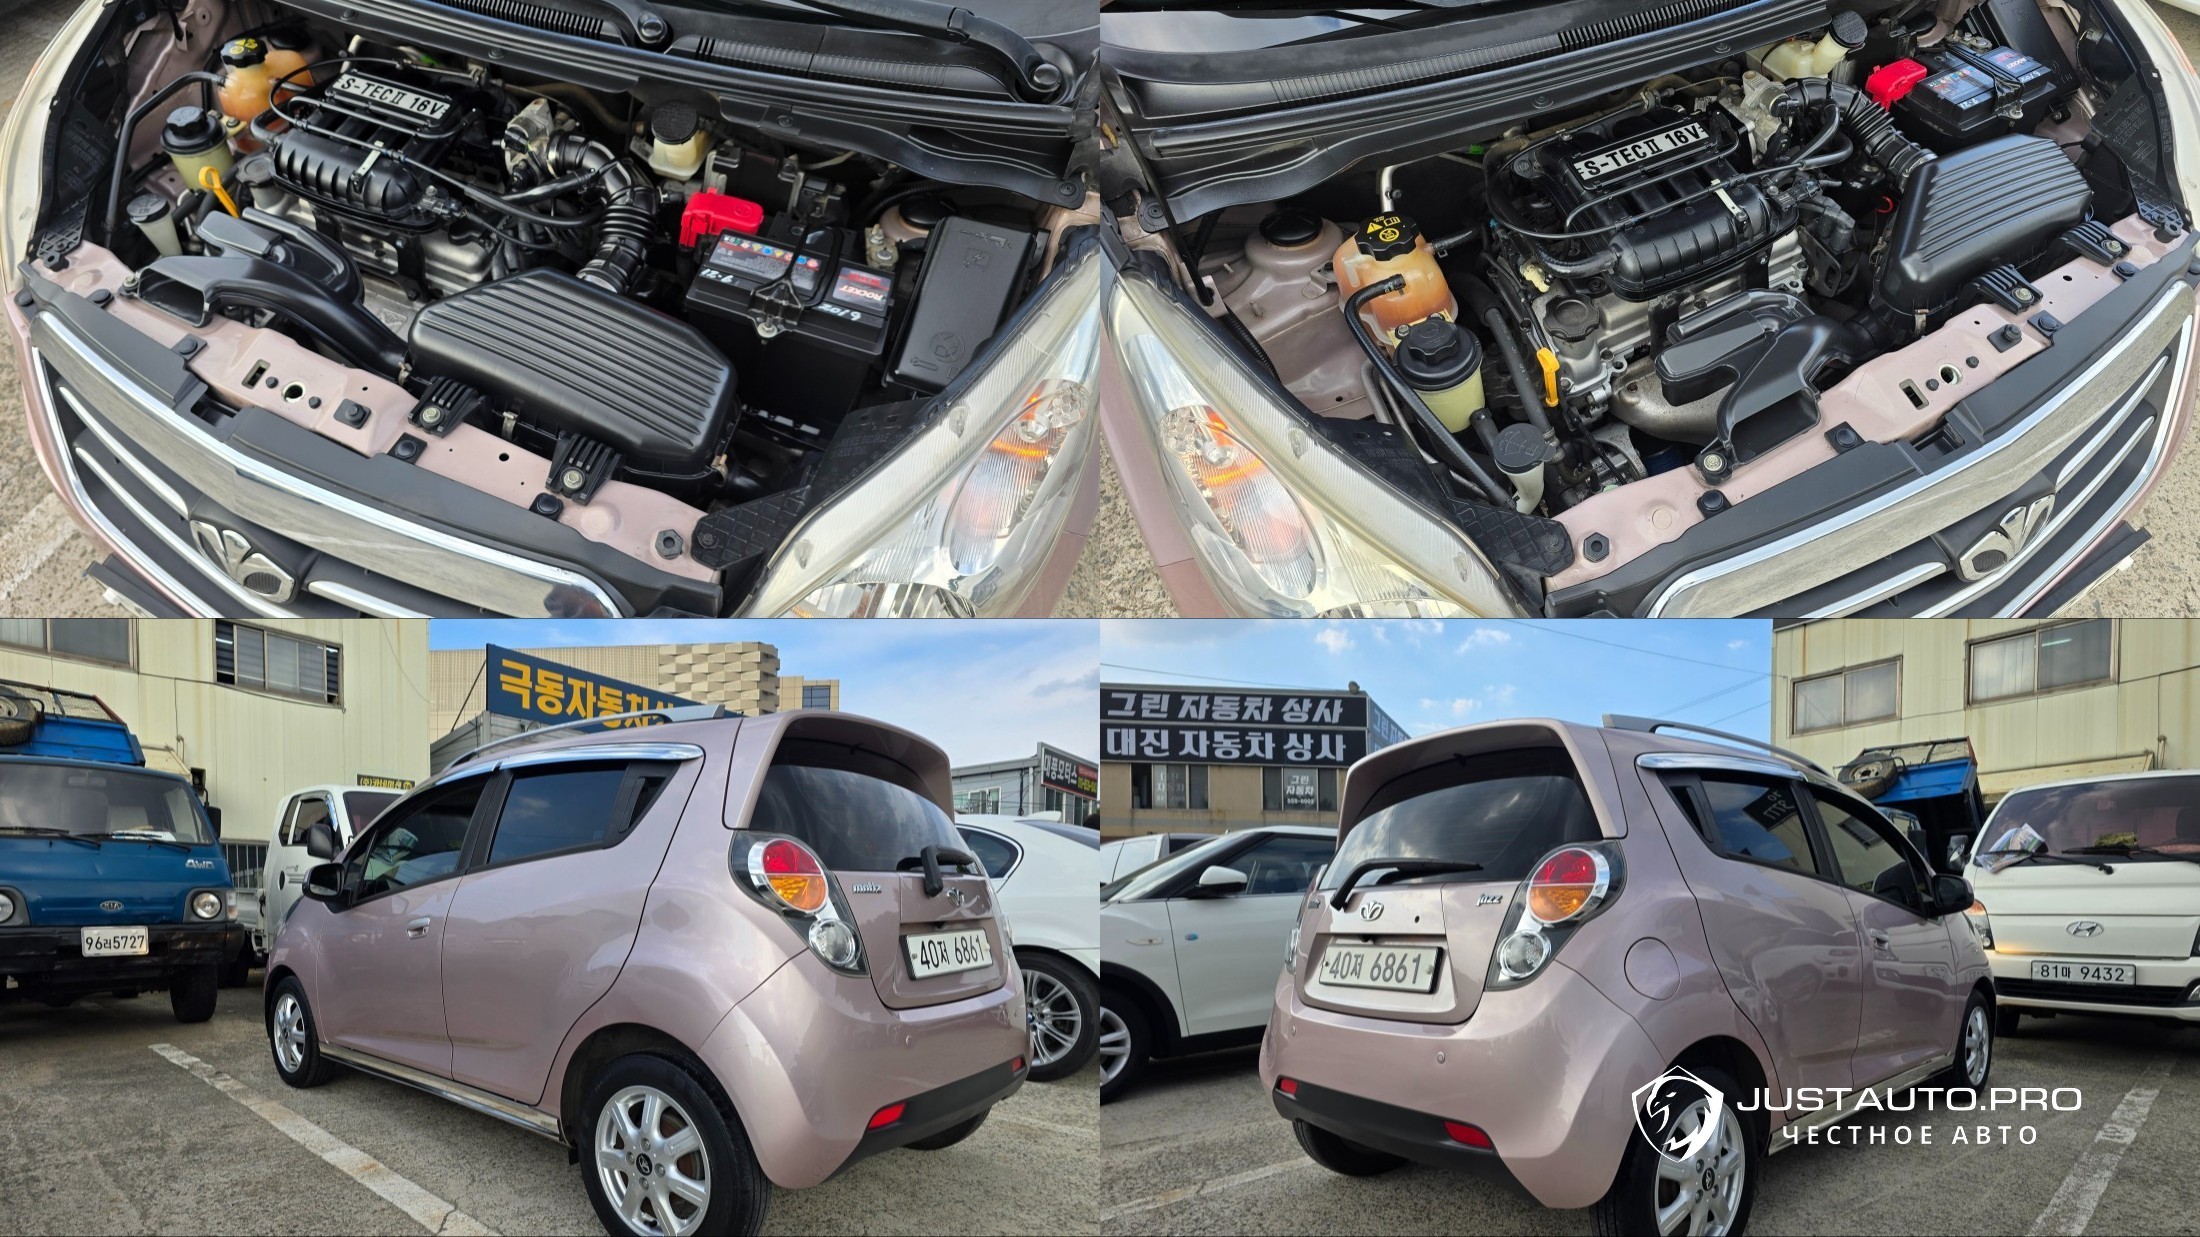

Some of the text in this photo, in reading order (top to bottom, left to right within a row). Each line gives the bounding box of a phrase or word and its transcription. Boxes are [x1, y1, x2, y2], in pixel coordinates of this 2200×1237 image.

[409, 97, 445, 116] 16V
[1665, 125, 1702, 148] 16V
[841, 284, 884, 302] ROCKET
[1107, 691, 1344, 724] 그린 자동차 상사
[1106, 728, 1347, 762] 대진 자동차 상사
[102, 901, 121, 910] KIA
[954, 933, 985, 965] 6861
[1369, 952, 1421, 985] 6861
[2040, 964, 2125, 982] 81마 9432
